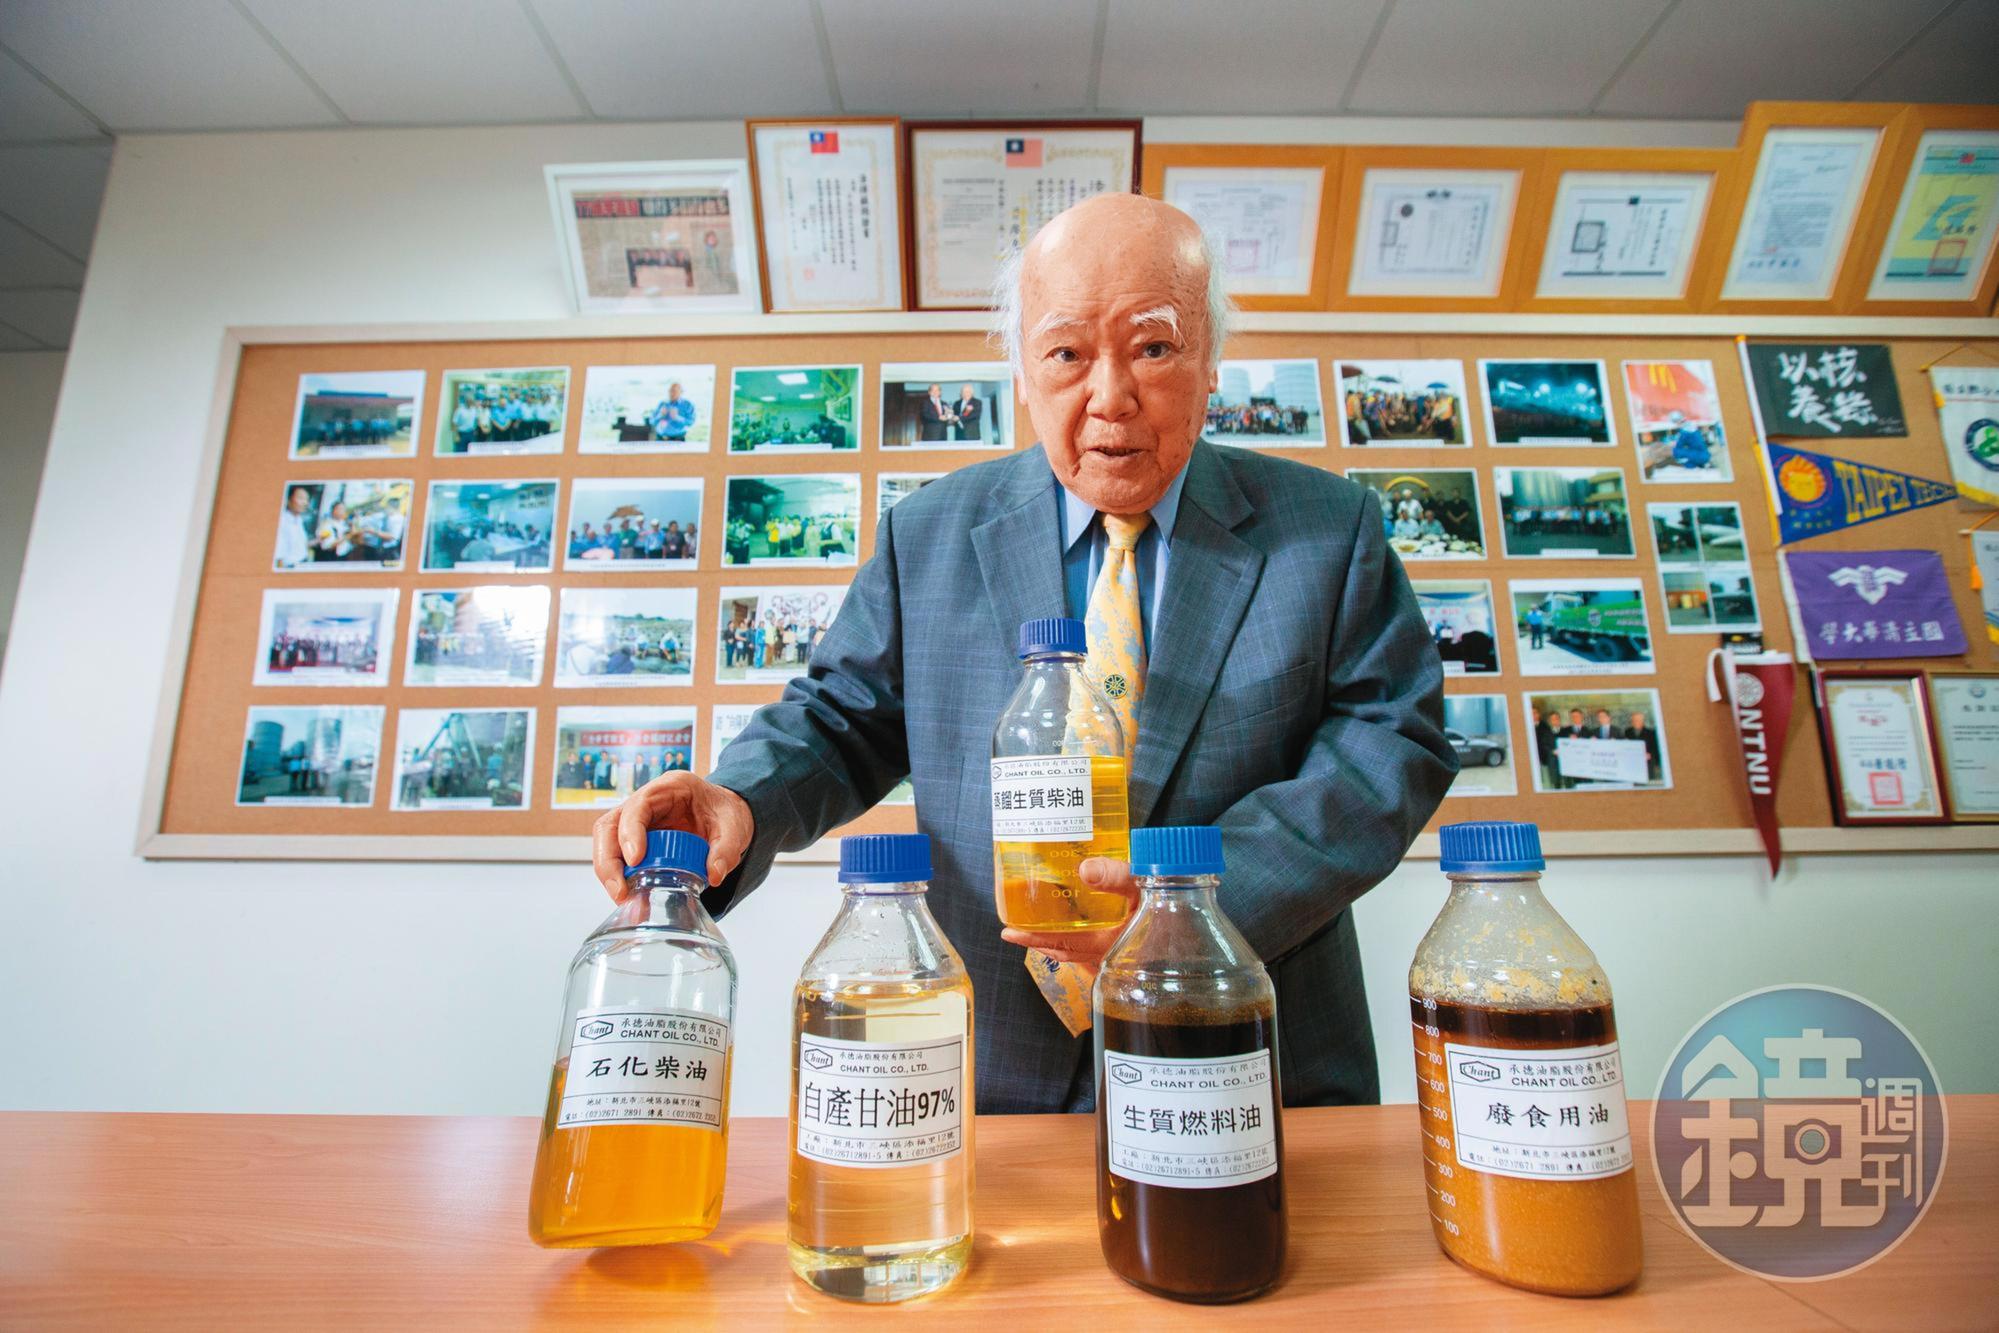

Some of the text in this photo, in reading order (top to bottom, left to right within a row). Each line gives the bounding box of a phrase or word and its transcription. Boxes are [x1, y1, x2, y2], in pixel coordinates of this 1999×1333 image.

[1832, 460, 1911, 523] TAIPEI
[1740, 708, 1771, 795] NTNU
[621, 1018, 721, 1037] 承德油脂股份有限公司
[621, 1030, 659, 1039] CHANT
[662, 1031, 679, 1040] OIL
[1425, 1026, 1440, 1038] 800
[1428, 1052, 1442, 1065] 700
[586, 1055, 708, 1081] 石化柴油
[840, 1064, 928, 1074] CHANT OIL CO., LTD.
[1113, 1067, 1138, 1080] Chant
[1462, 1064, 1496, 1078] Chant
[1151, 1080, 1193, 1088] CHANT
[1199, 1080, 1219, 1088] OIL
[1430, 1079, 1445, 1093] 600
[1512, 1078, 1556, 1087] CHANT
[1559, 1078, 1578, 1086] OIL
[804, 1082, 955, 1129] 自產甘油97%
[1123, 1104, 1261, 1136] 生質燃料油
[1433, 1107, 1448, 1121] 500
[1486, 1103, 1609, 1128] 廢食用油
[1435, 1135, 1451, 1150] 400
[1438, 1163, 1453, 1178] 300
[1440, 1191, 1456, 1207] 200
[1443, 1220, 1459, 1236] 100
